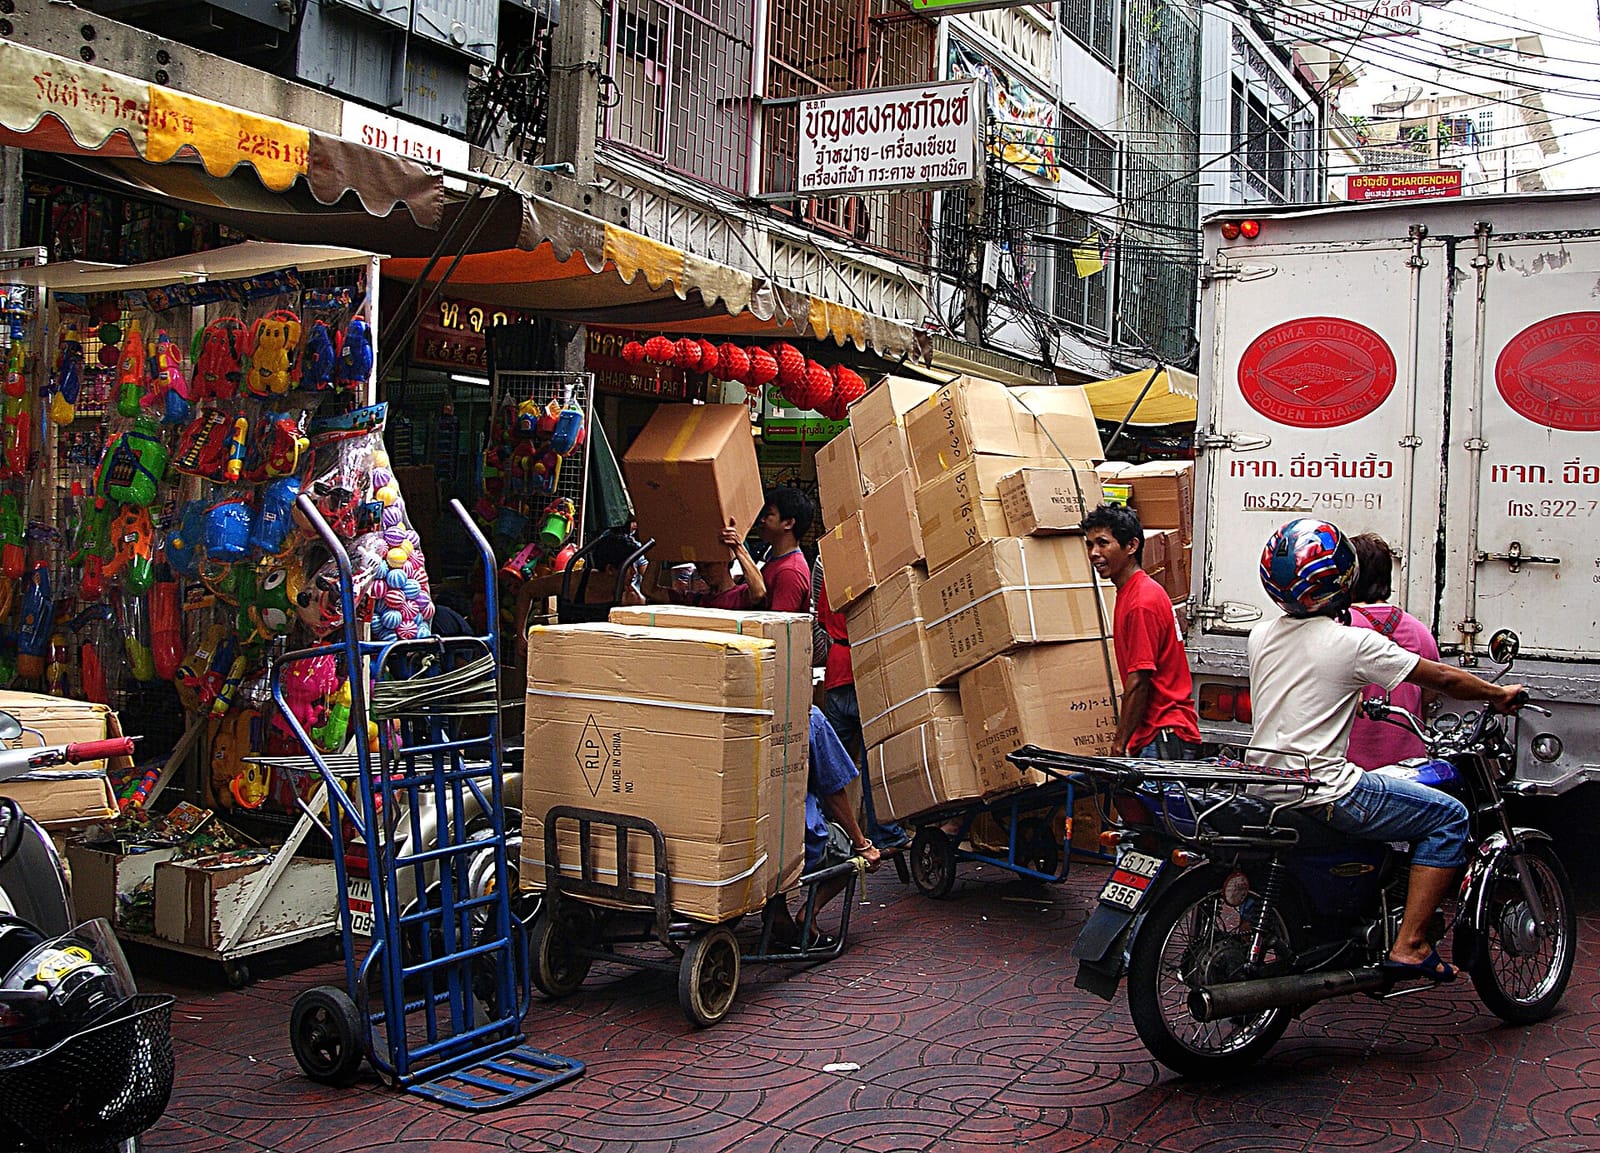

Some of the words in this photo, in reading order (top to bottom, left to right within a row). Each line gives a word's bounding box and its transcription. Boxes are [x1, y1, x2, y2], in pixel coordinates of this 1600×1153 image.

[805, 88, 970, 148] บุญทองคหภัณฑ์
[868, 165, 915, 181] กระดาษ
[920, 158, 967, 182] ทุกชนิด
[1392, 175, 1457, 186] CHAROENCHAI
[1258, 326, 1306, 353] PRIMA
[1316, 324, 1381, 351] QUALITY
[1520, 321, 1575, 350] PRIMA
[1253, 391, 1306, 421] GOLDEN
[1312, 390, 1380, 421] TRIANGLE
[1513, 391, 1575, 422] GOLDEN
[1230, 460, 1284, 478] หจก.
[1491, 464, 1553, 484] หจก.
[612, 732, 622, 757] CHINA
[1073, 735, 1095, 746] CHINA
[585, 740, 600, 769] RLP
[612, 759, 621, 767] IN
[612, 769, 622, 793] MADE
[1107, 885, 1136, 904] 356
